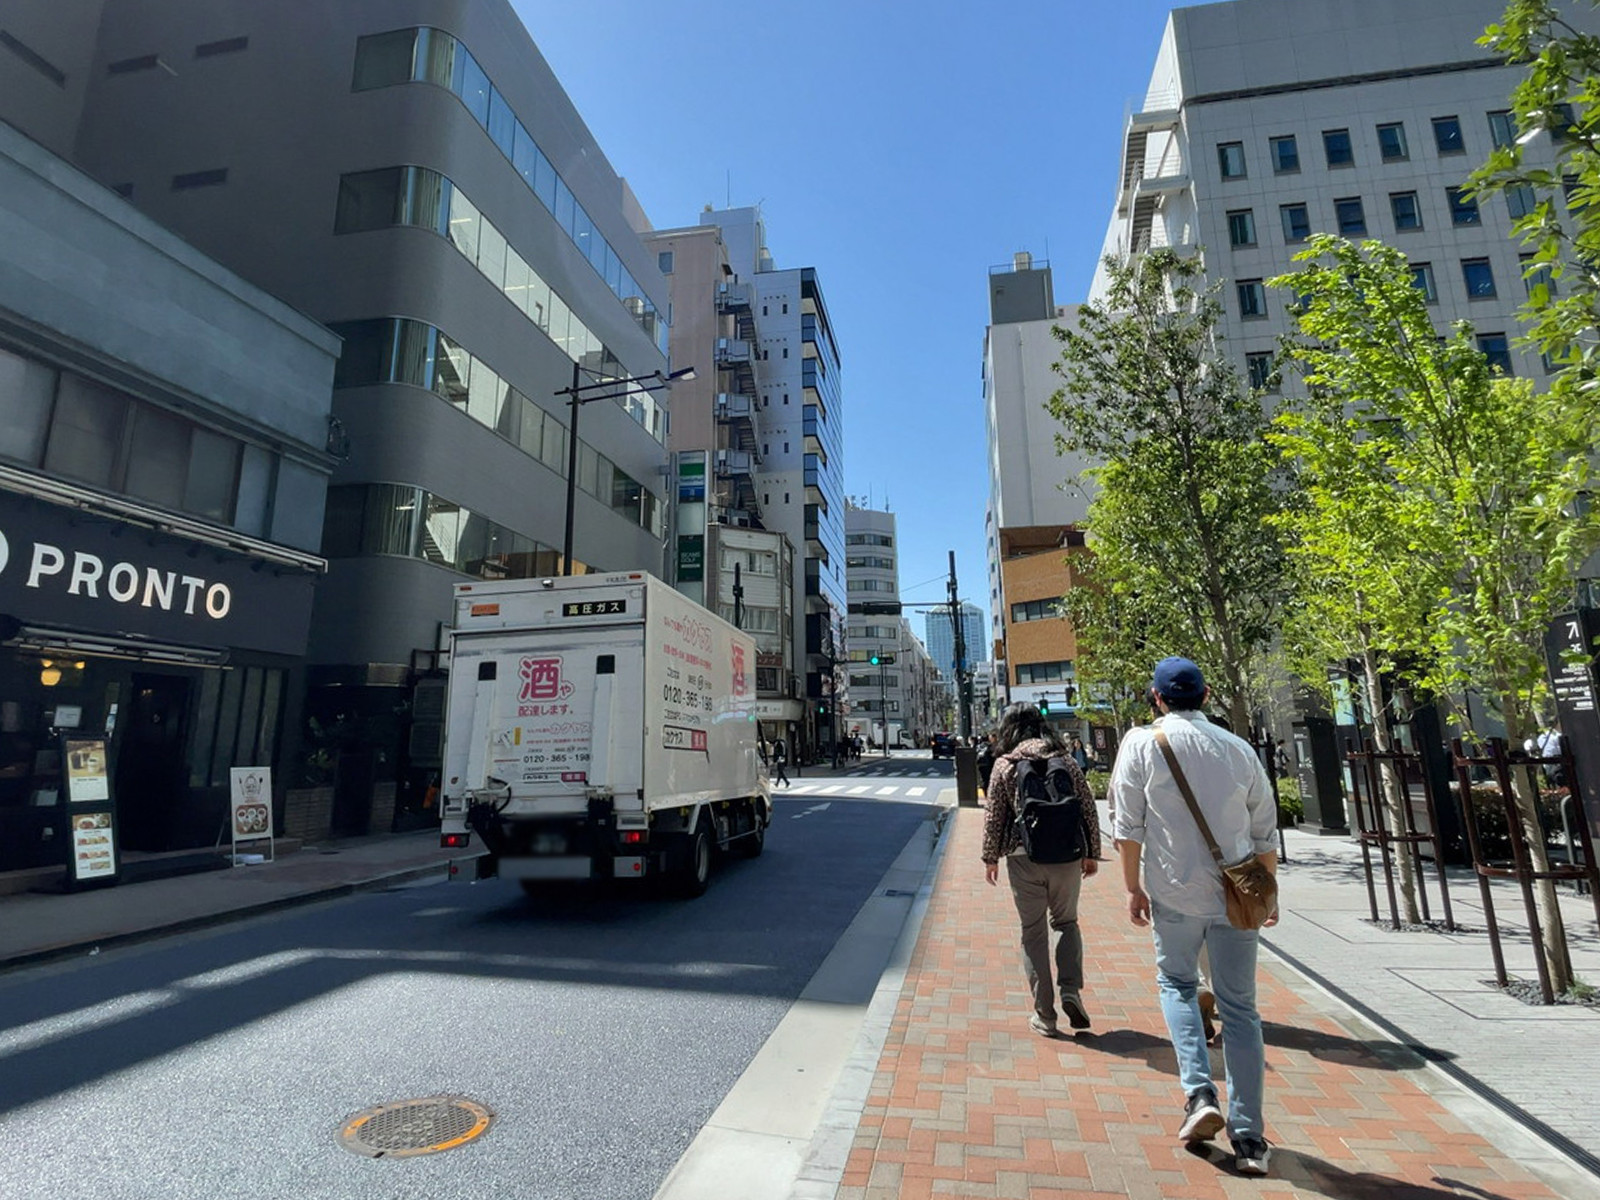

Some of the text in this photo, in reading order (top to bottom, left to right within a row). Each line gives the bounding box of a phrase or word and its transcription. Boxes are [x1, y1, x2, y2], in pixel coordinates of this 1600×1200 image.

[26, 542, 231, 619] PRONTO
[568, 601, 620, 615] 高圧ガス
